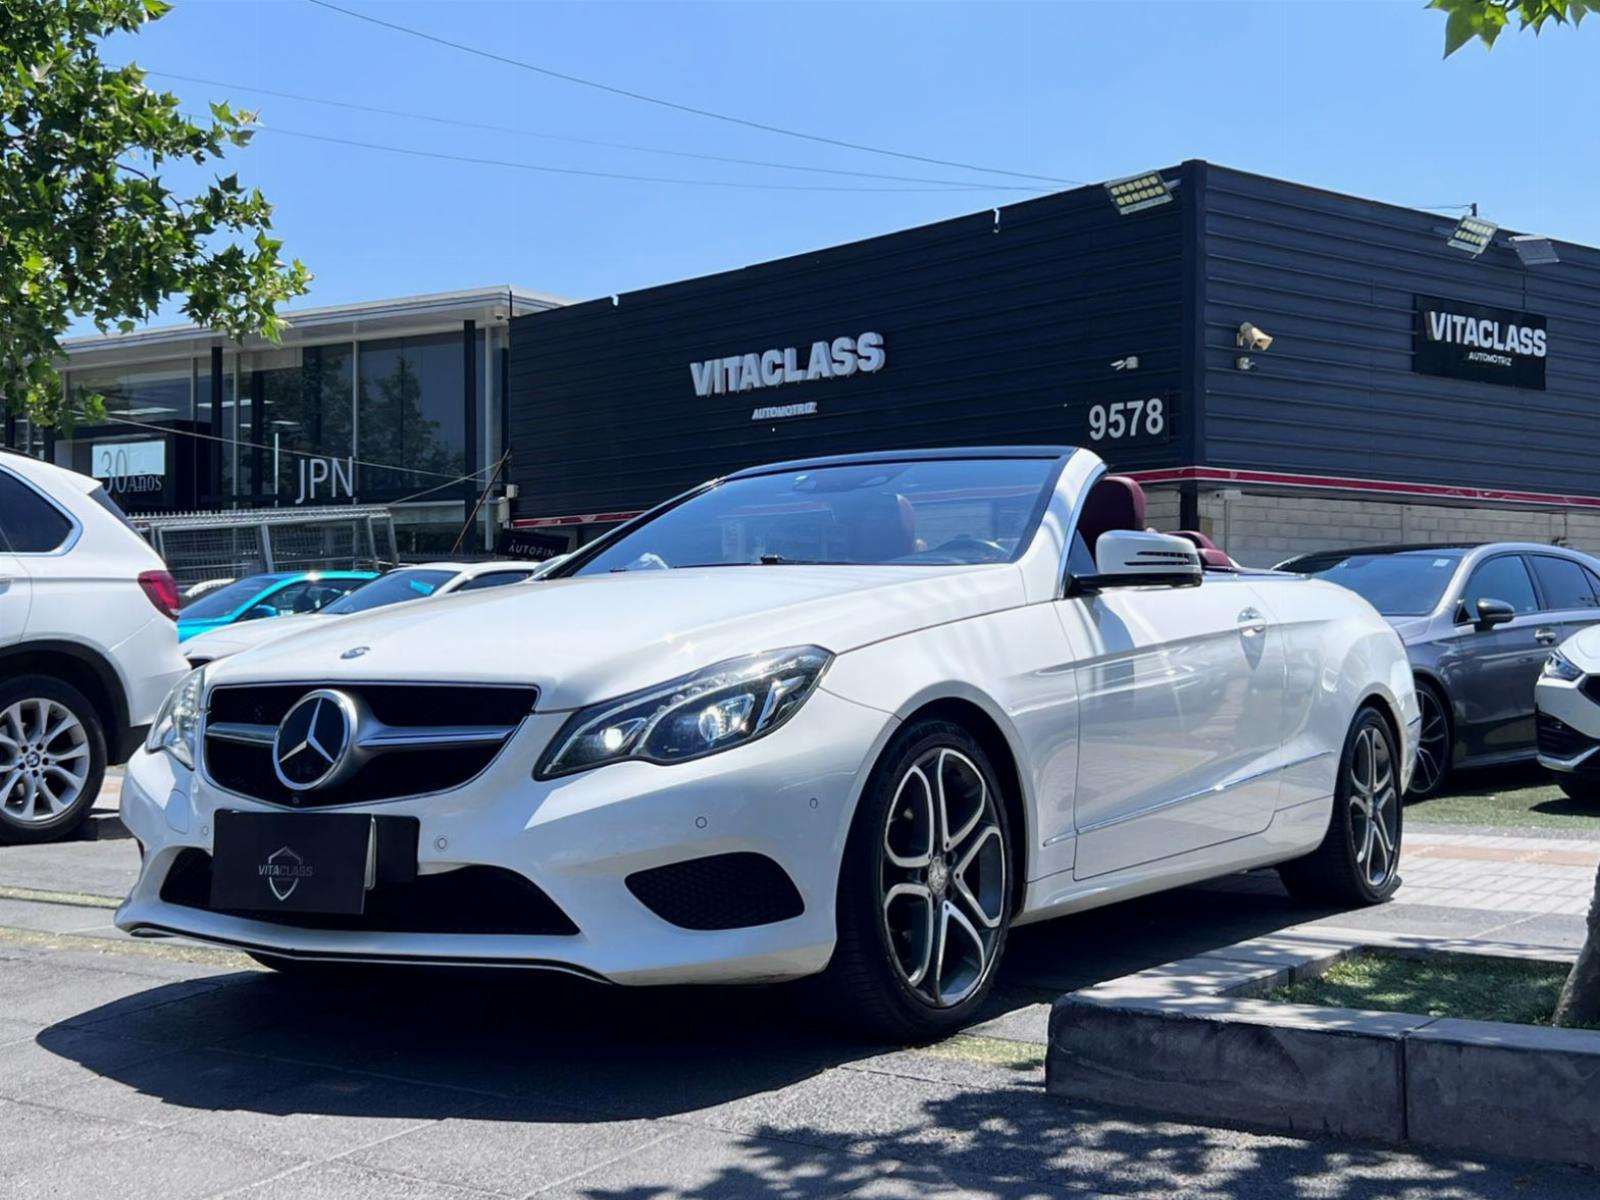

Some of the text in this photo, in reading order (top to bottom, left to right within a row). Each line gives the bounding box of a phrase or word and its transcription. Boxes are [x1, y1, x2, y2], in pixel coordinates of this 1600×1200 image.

[1430, 311, 1546, 357] VITACLASS
[690, 332, 885, 396] VITACLASS
[1468, 351, 1512, 367] AUTOMOTRIZ
[752, 402, 818, 420] AUTOMOTRIZ
[1088, 398, 1164, 441] 9578
[295, 456, 354, 504] JPN
[258, 864, 313, 876] VITACLASS
